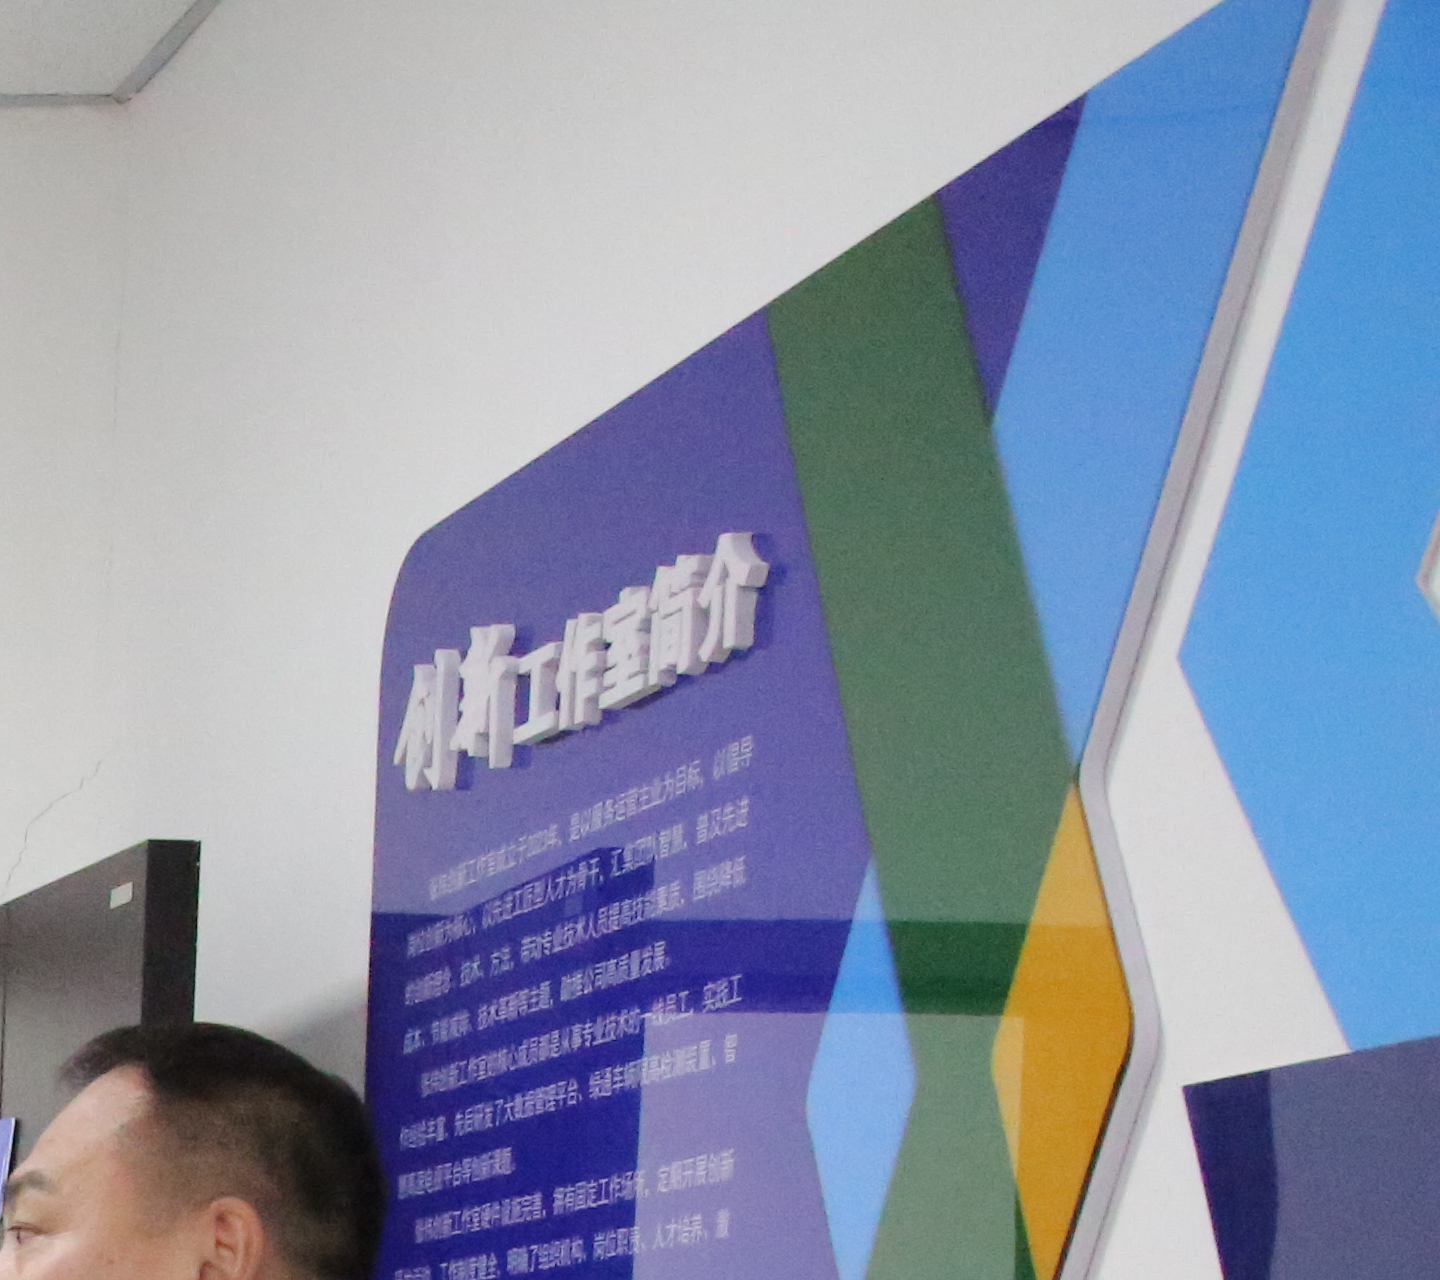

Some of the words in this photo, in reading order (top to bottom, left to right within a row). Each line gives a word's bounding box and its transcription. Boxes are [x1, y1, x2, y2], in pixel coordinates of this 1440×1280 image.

[393, 531, 770, 792] 创新工作室简介
